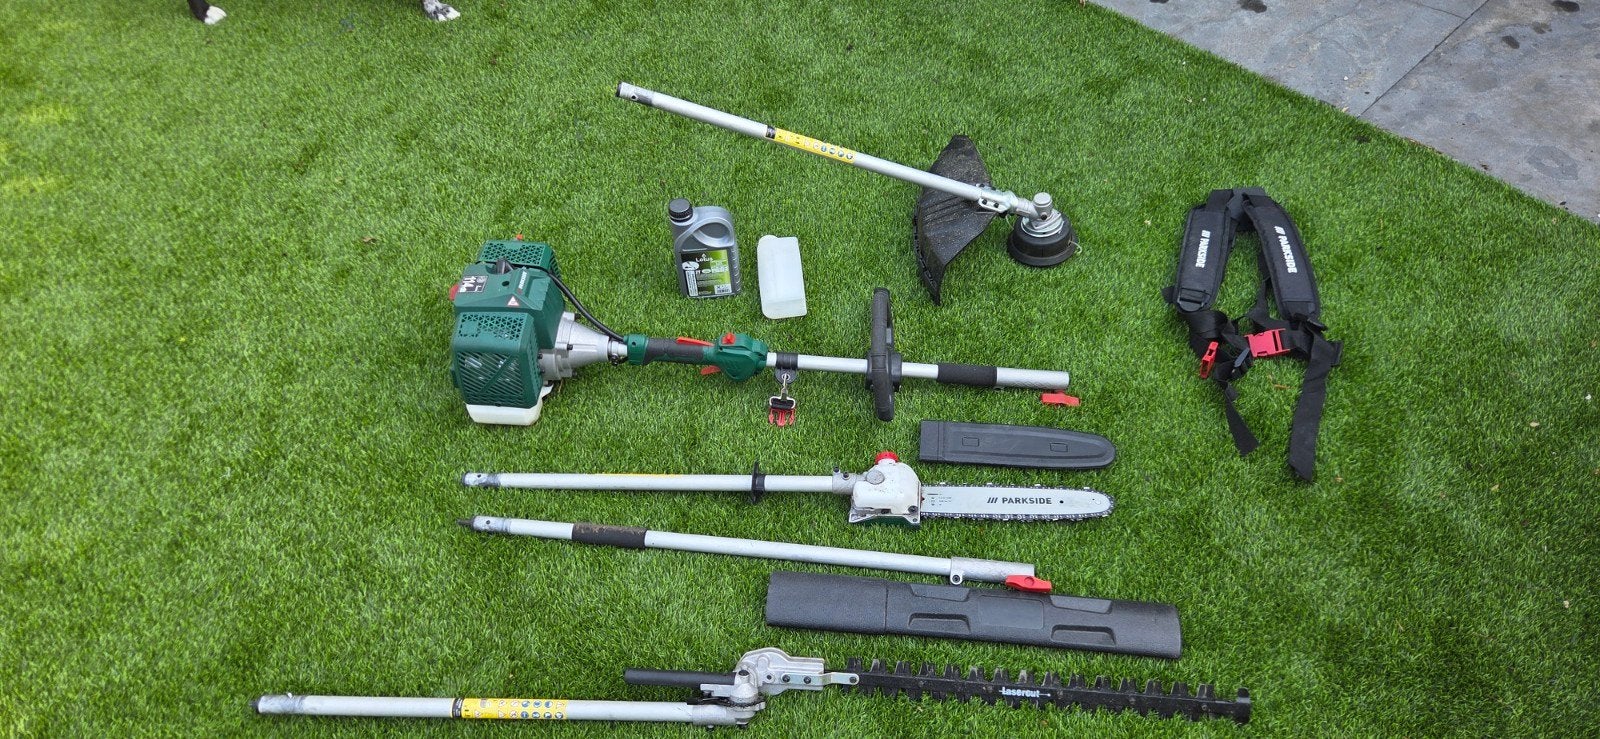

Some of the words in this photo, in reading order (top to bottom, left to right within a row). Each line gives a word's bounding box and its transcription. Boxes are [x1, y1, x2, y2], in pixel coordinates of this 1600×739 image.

[1278, 235, 1298, 273] PARKSIDE
[1001, 497, 1052, 505] PARKSIDE
[1001, 686, 1040, 698] Lasercut
